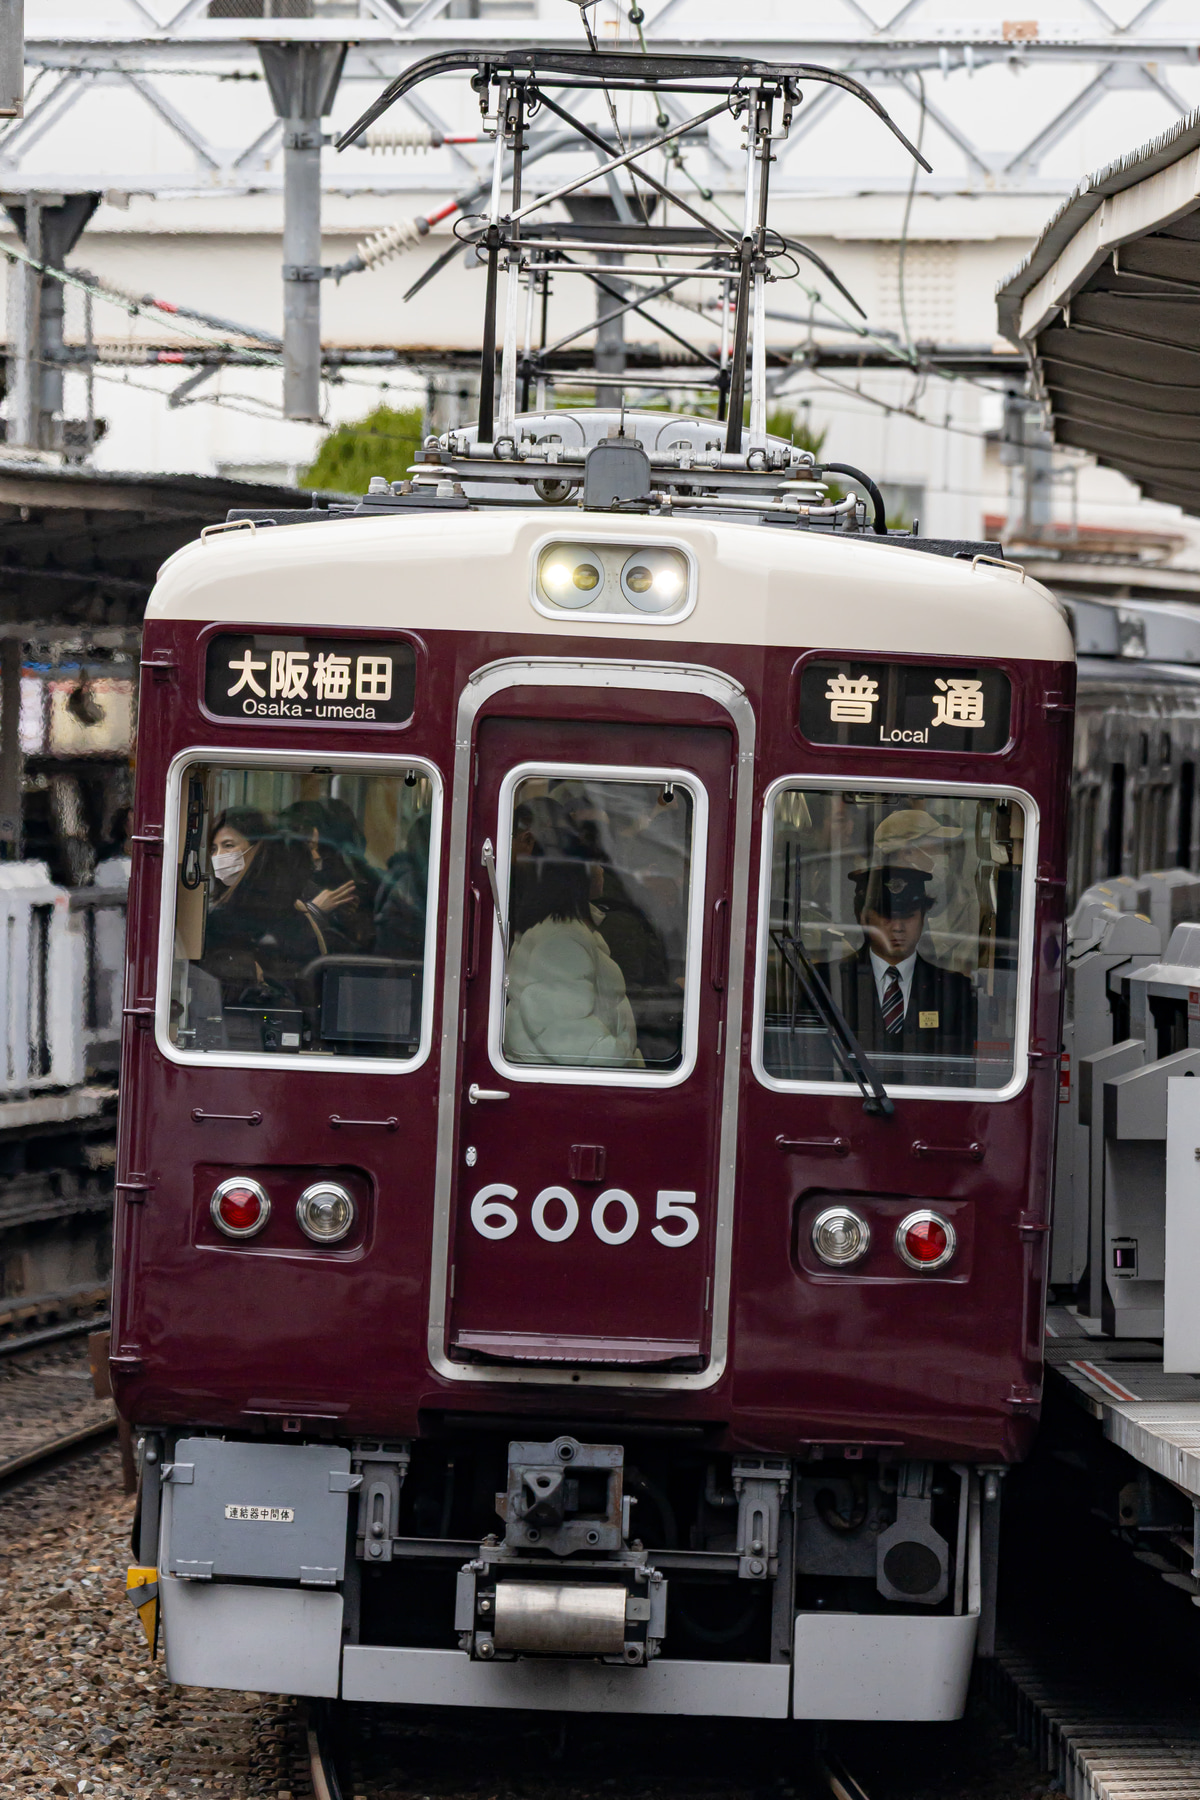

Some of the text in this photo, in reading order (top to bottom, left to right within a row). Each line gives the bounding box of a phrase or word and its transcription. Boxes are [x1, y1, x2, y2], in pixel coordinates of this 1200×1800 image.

[227, 649, 393, 701] 大阪梅田
[242, 699, 377, 720] Osaka-umeda
[825, 673, 985, 728] 普通
[879, 725, 929, 744] Local
[470, 1183, 700, 1248] 6005
[229, 1506, 290, 1521] 連結器中間体
